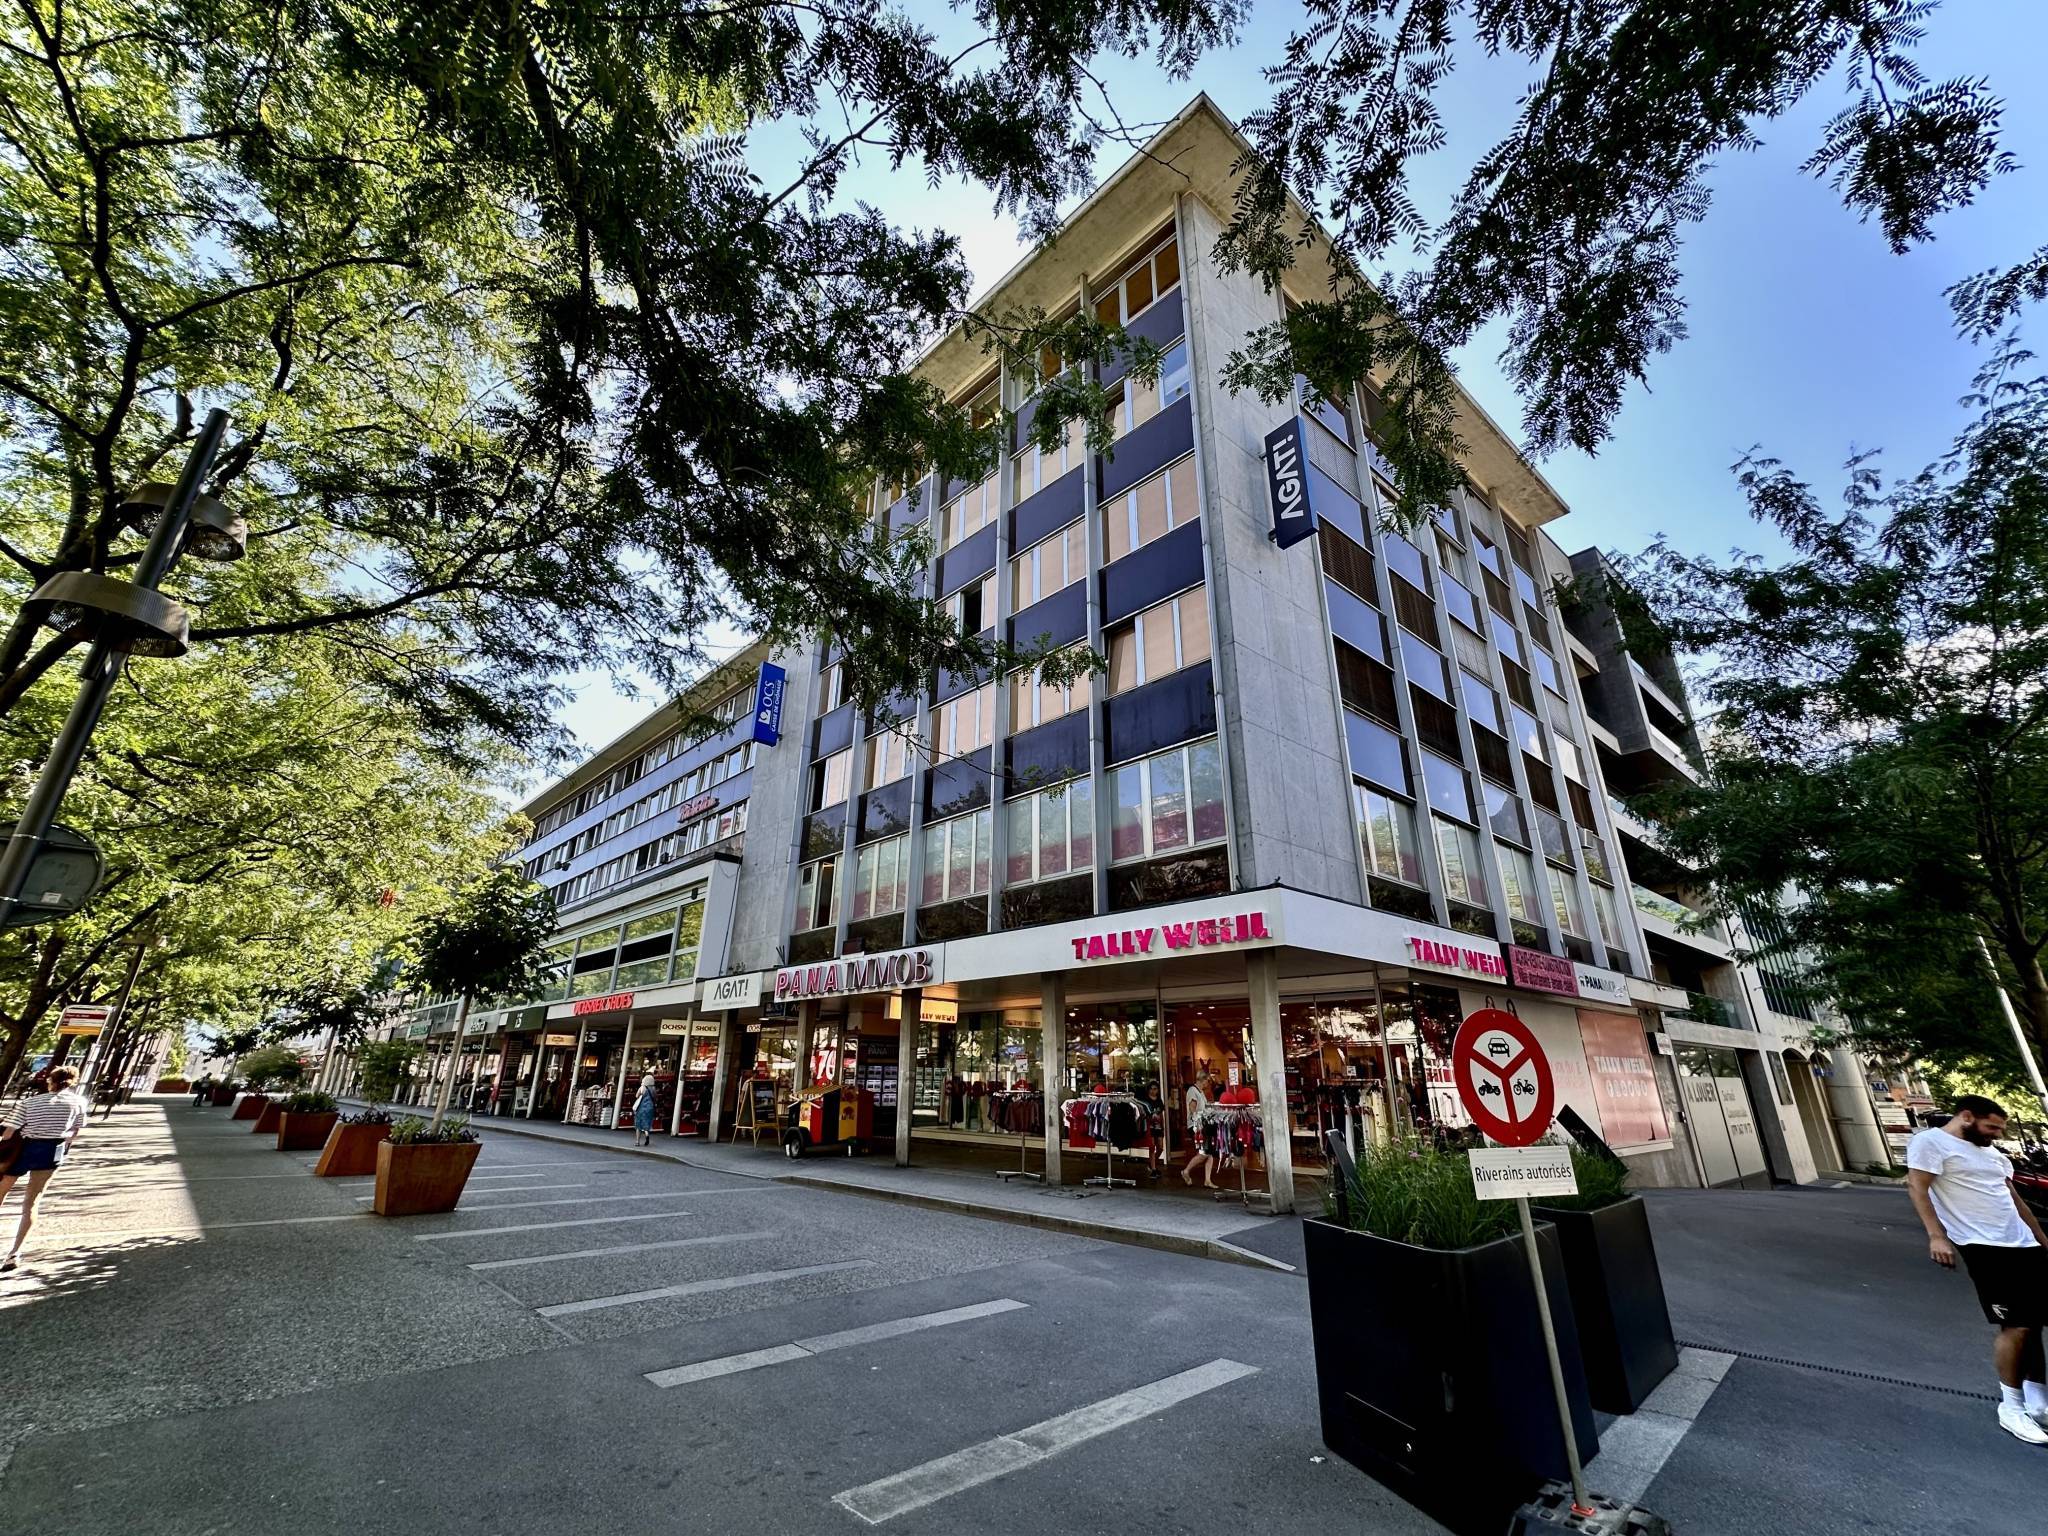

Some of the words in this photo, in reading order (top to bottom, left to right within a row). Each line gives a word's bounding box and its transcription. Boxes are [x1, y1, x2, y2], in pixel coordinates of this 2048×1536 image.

[1272, 434, 1305, 520] AGAT!
[763, 680, 775, 707] OCS
[1072, 928, 1155, 960] TALLY
[1411, 937, 1460, 967] TALLY
[607, 992, 634, 1010] SHOES
[714, 979, 749, 1000] AGAT!
[1475, 1165, 1523, 1182] Riverains
[1526, 1163, 1572, 1180] autorisés
